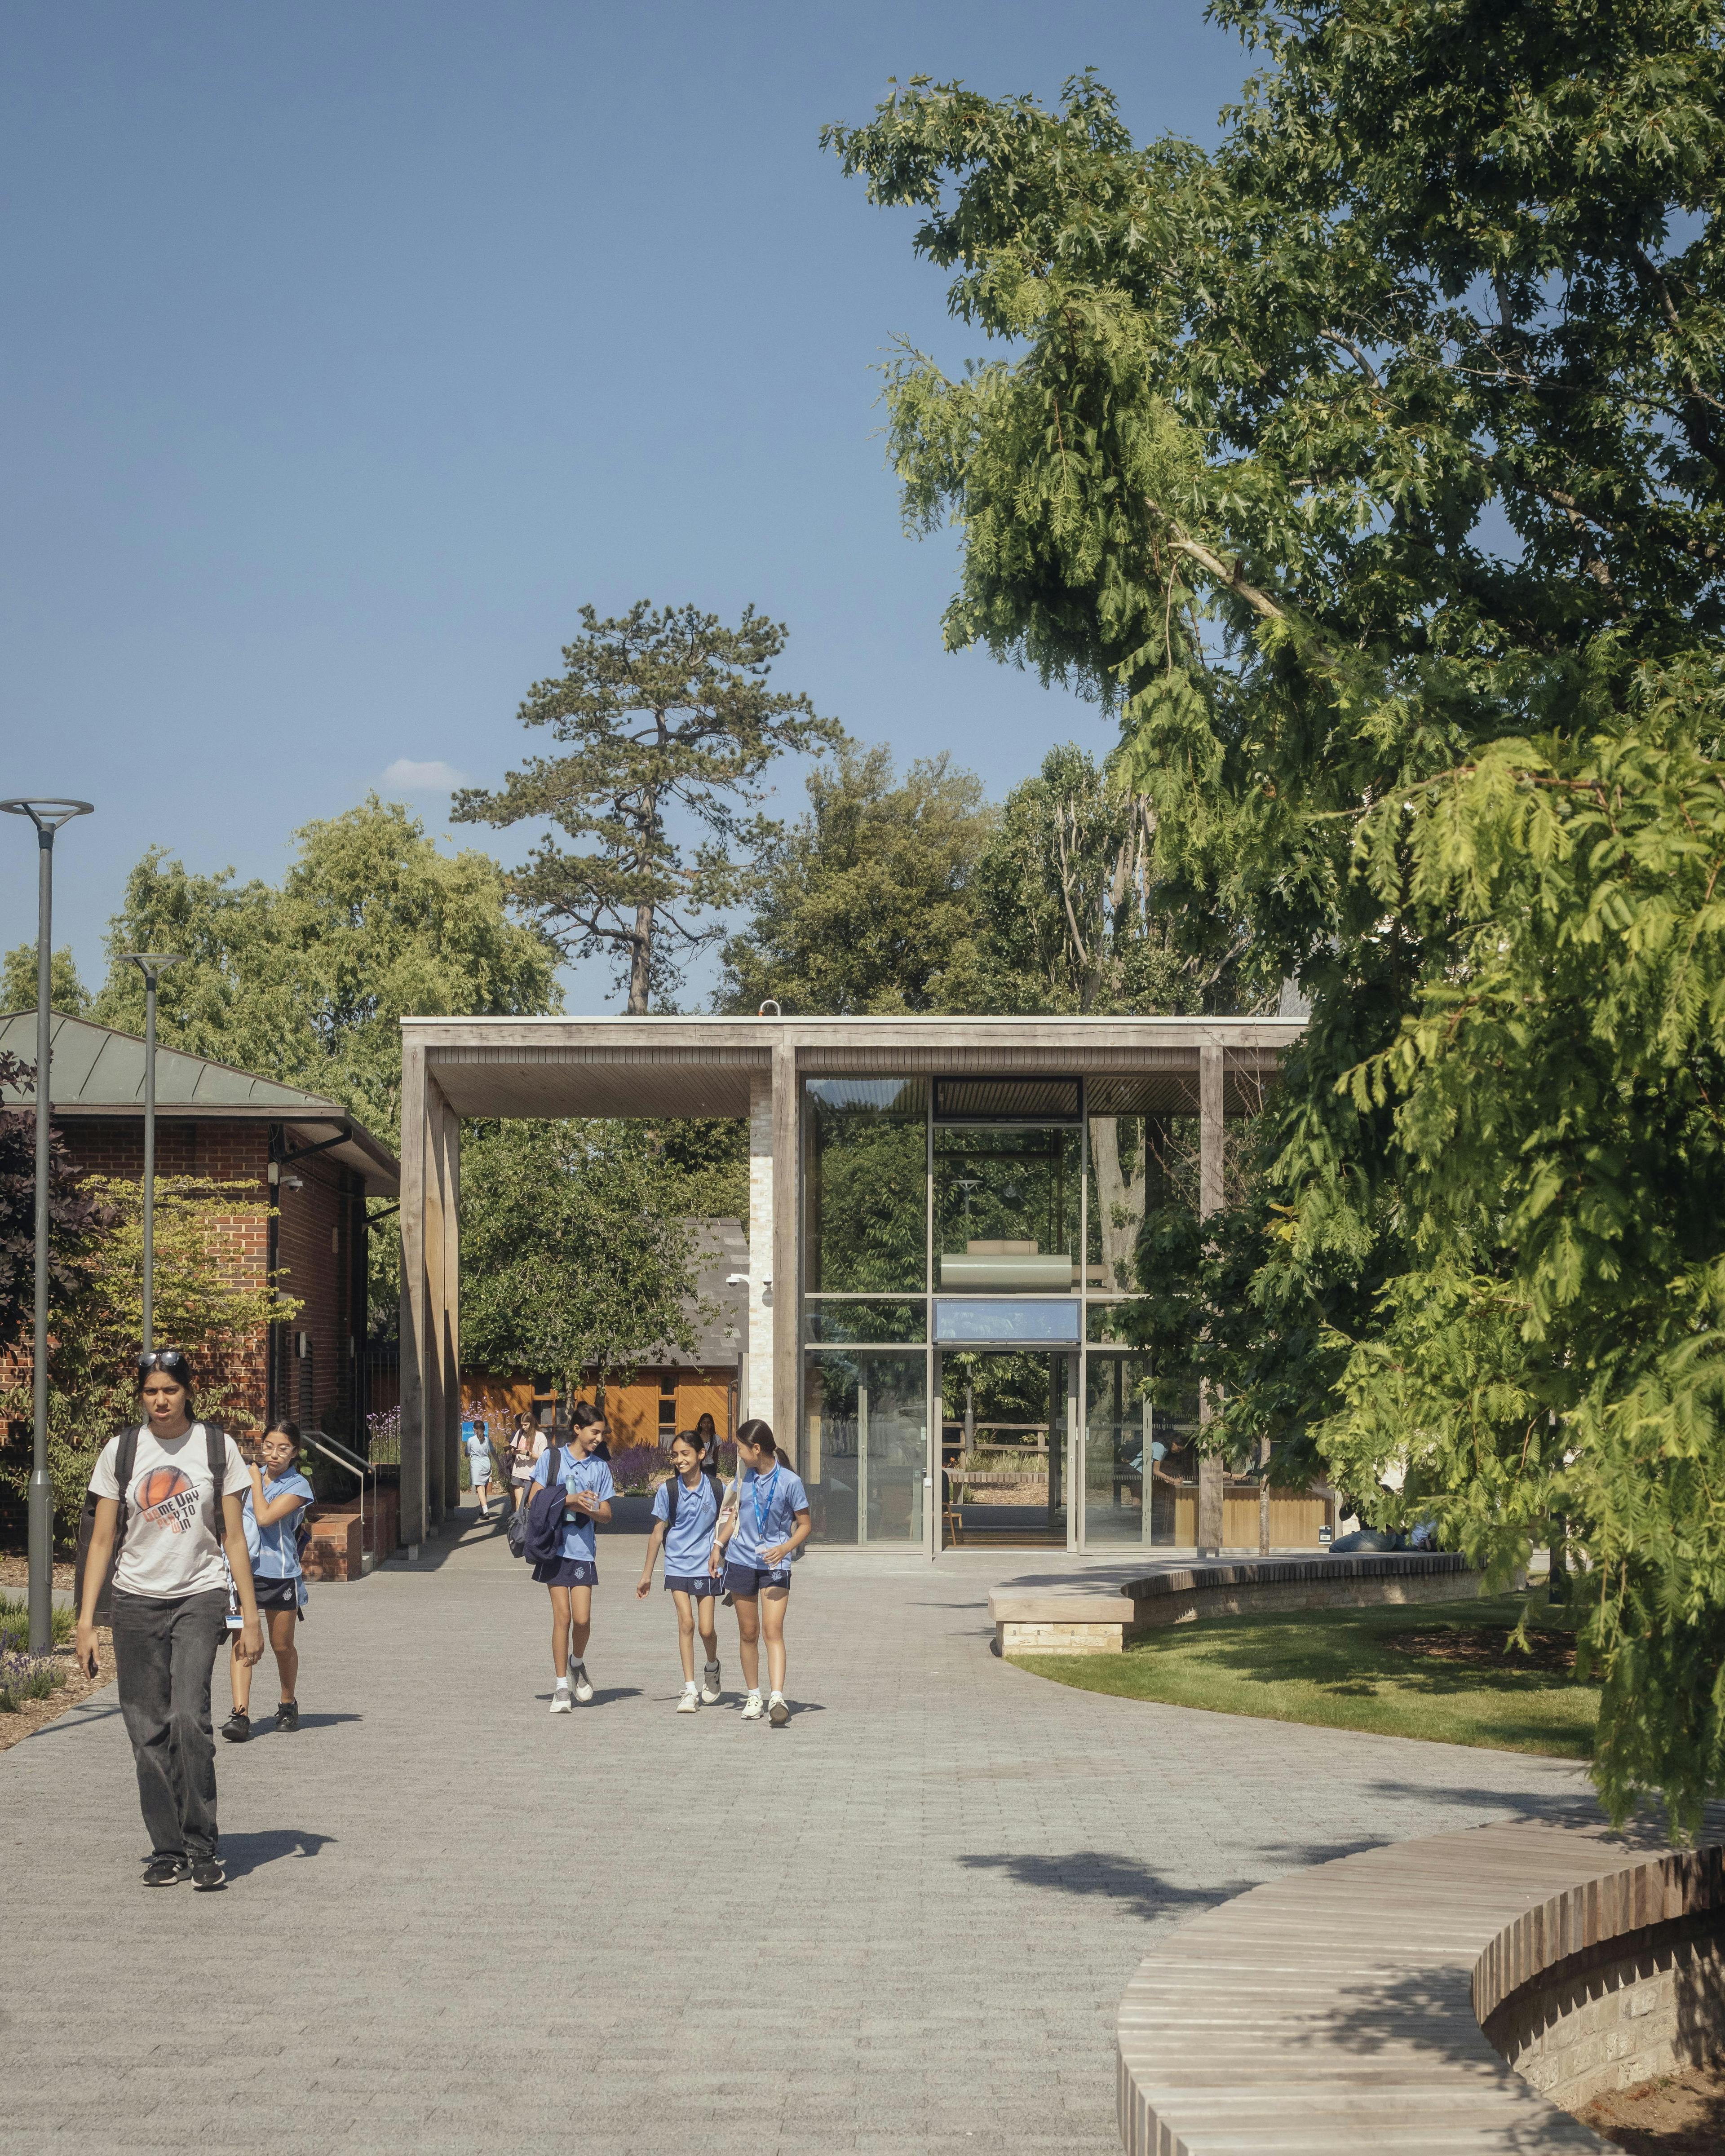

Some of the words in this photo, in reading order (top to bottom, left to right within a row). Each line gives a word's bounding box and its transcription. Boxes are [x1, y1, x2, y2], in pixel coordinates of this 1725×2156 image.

[174, 1490, 199, 1508] DAY
[156, 1511, 181, 1531] PLAY
[181, 1504, 196, 1517] TO
[172, 1518, 191, 1534] WIN
